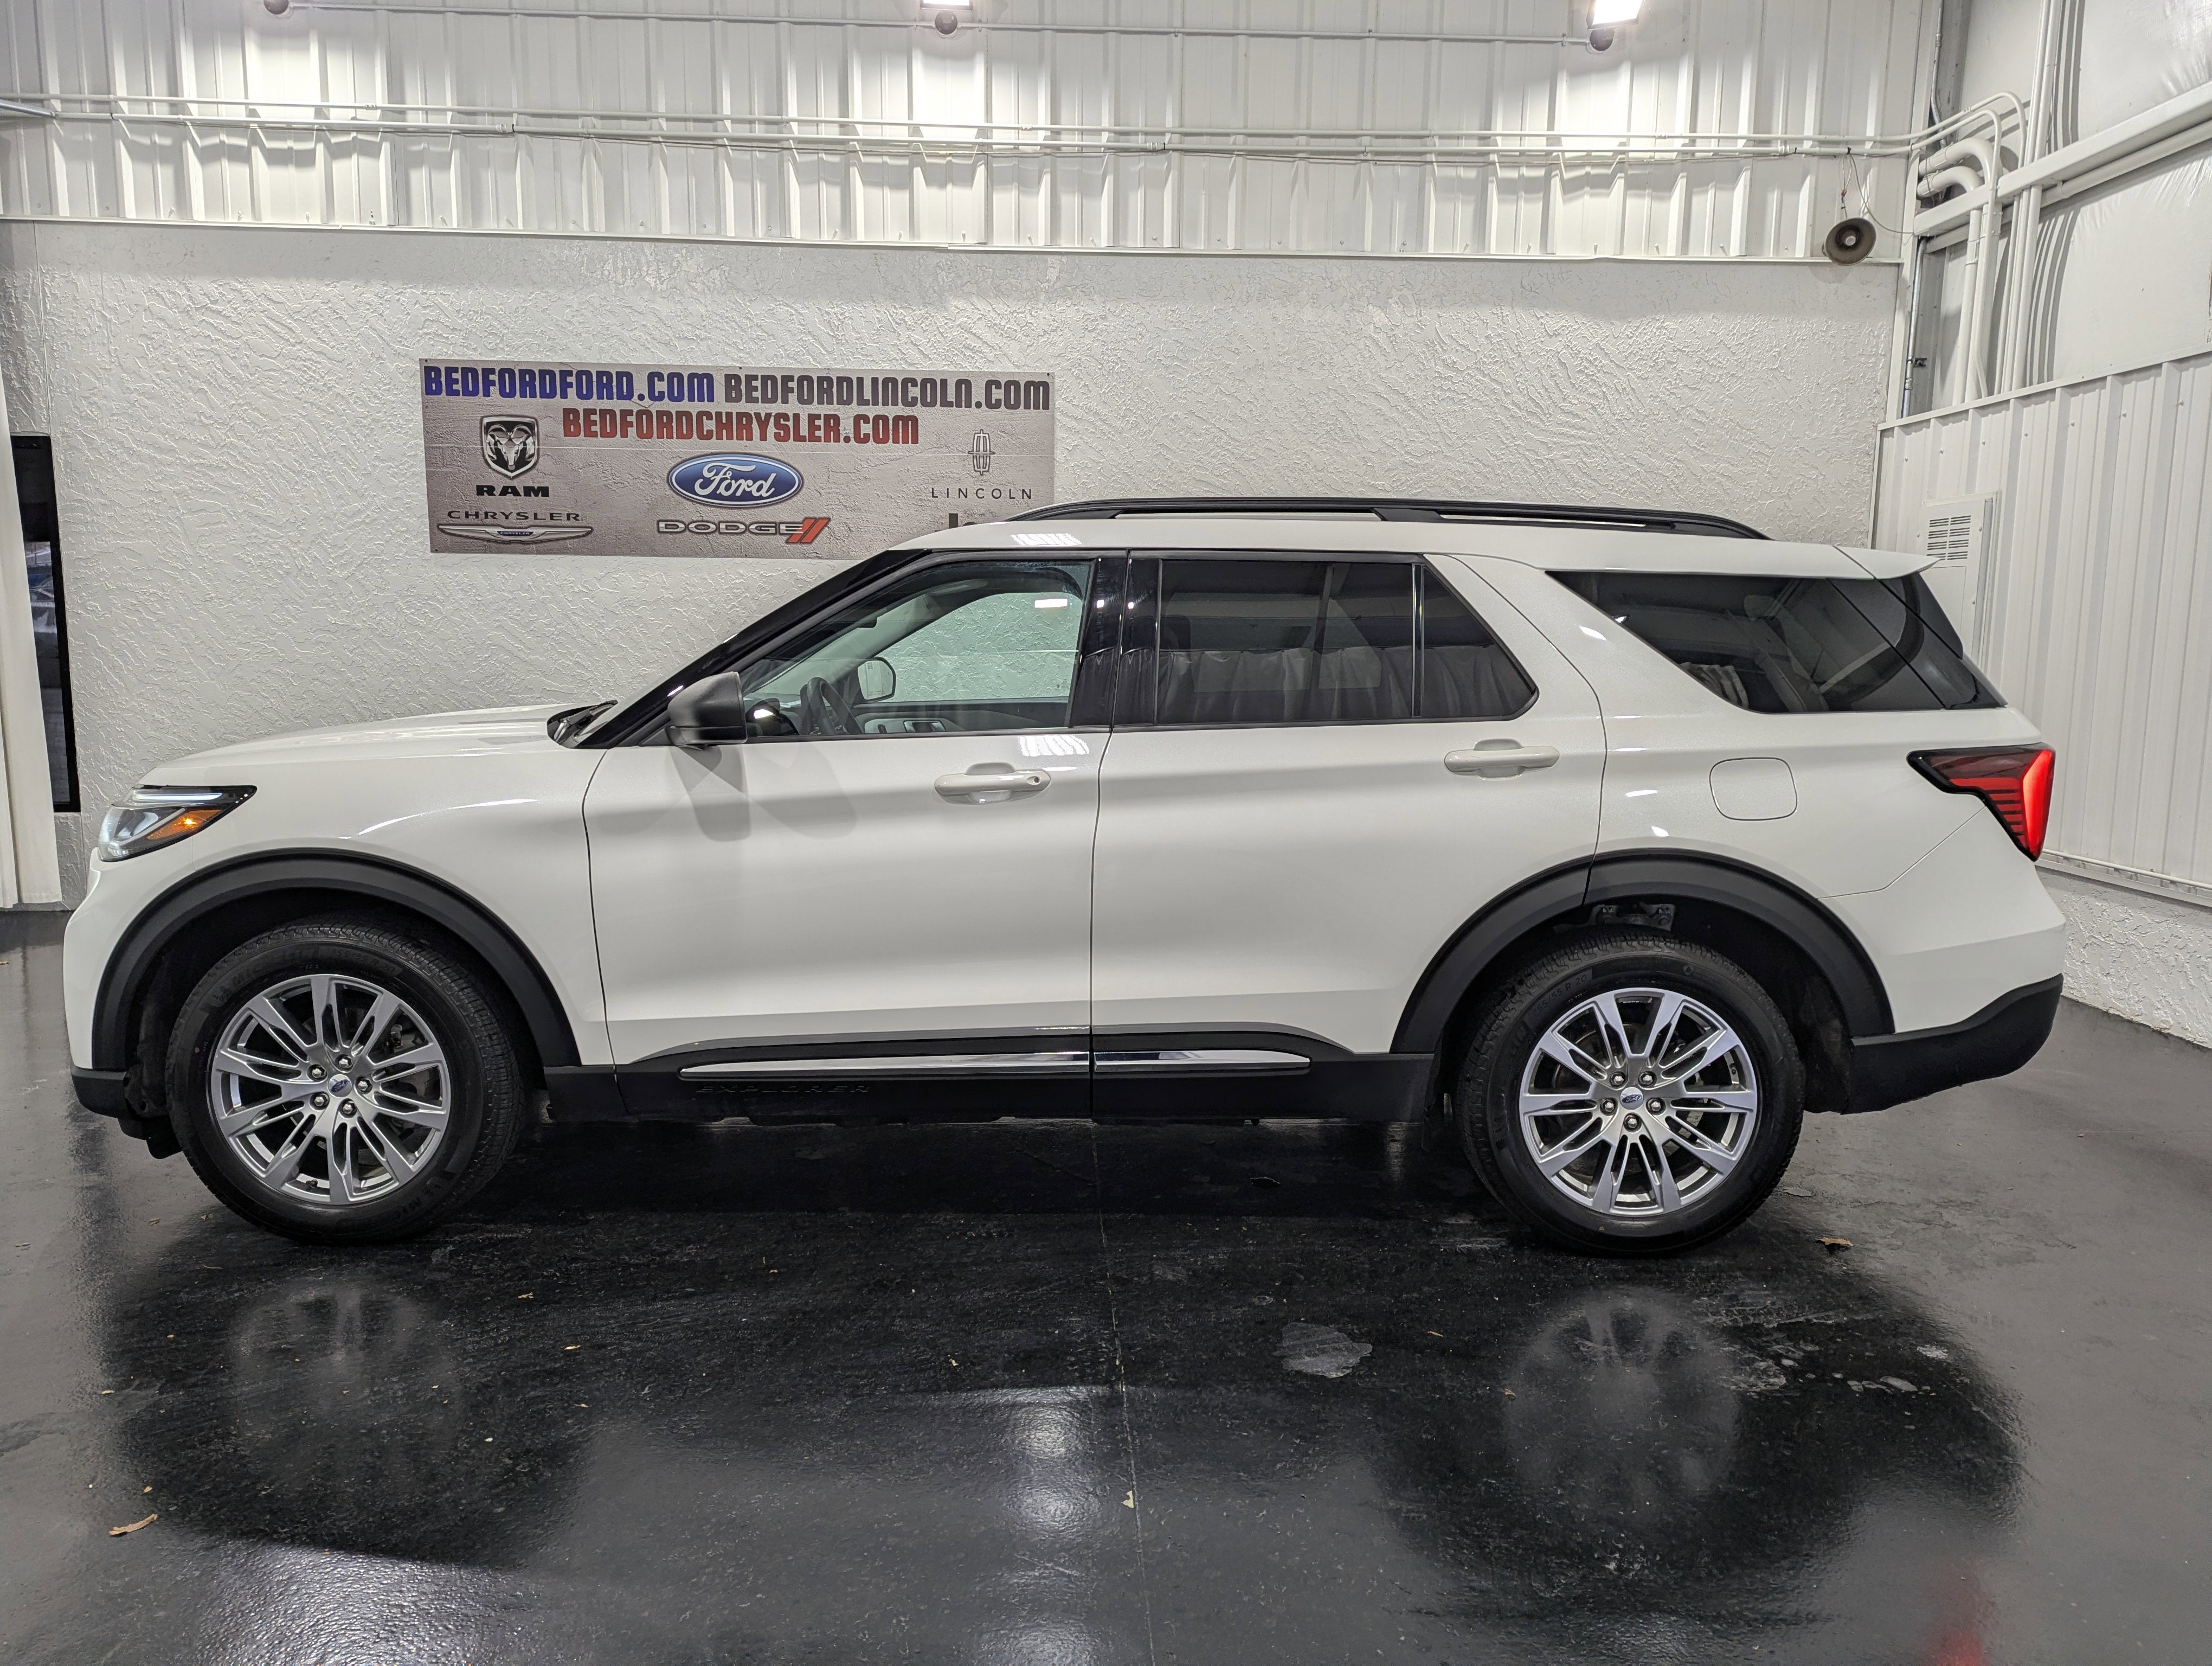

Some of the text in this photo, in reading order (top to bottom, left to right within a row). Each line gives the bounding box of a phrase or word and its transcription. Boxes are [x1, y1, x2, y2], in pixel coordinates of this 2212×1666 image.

[424, 366, 1050, 410] BEDFORDFORD.COM BEDFORDLINCOLN.COM
[563, 408, 919, 445] BEDFORDCHRYSLER.COM
[694, 462, 776, 497] Ford
[476, 484, 550, 497] RAM
[931, 487, 1032, 499] LINCOLN
[447, 510, 580, 521] CHRYSLER
[658, 519, 805, 535] DODGE
